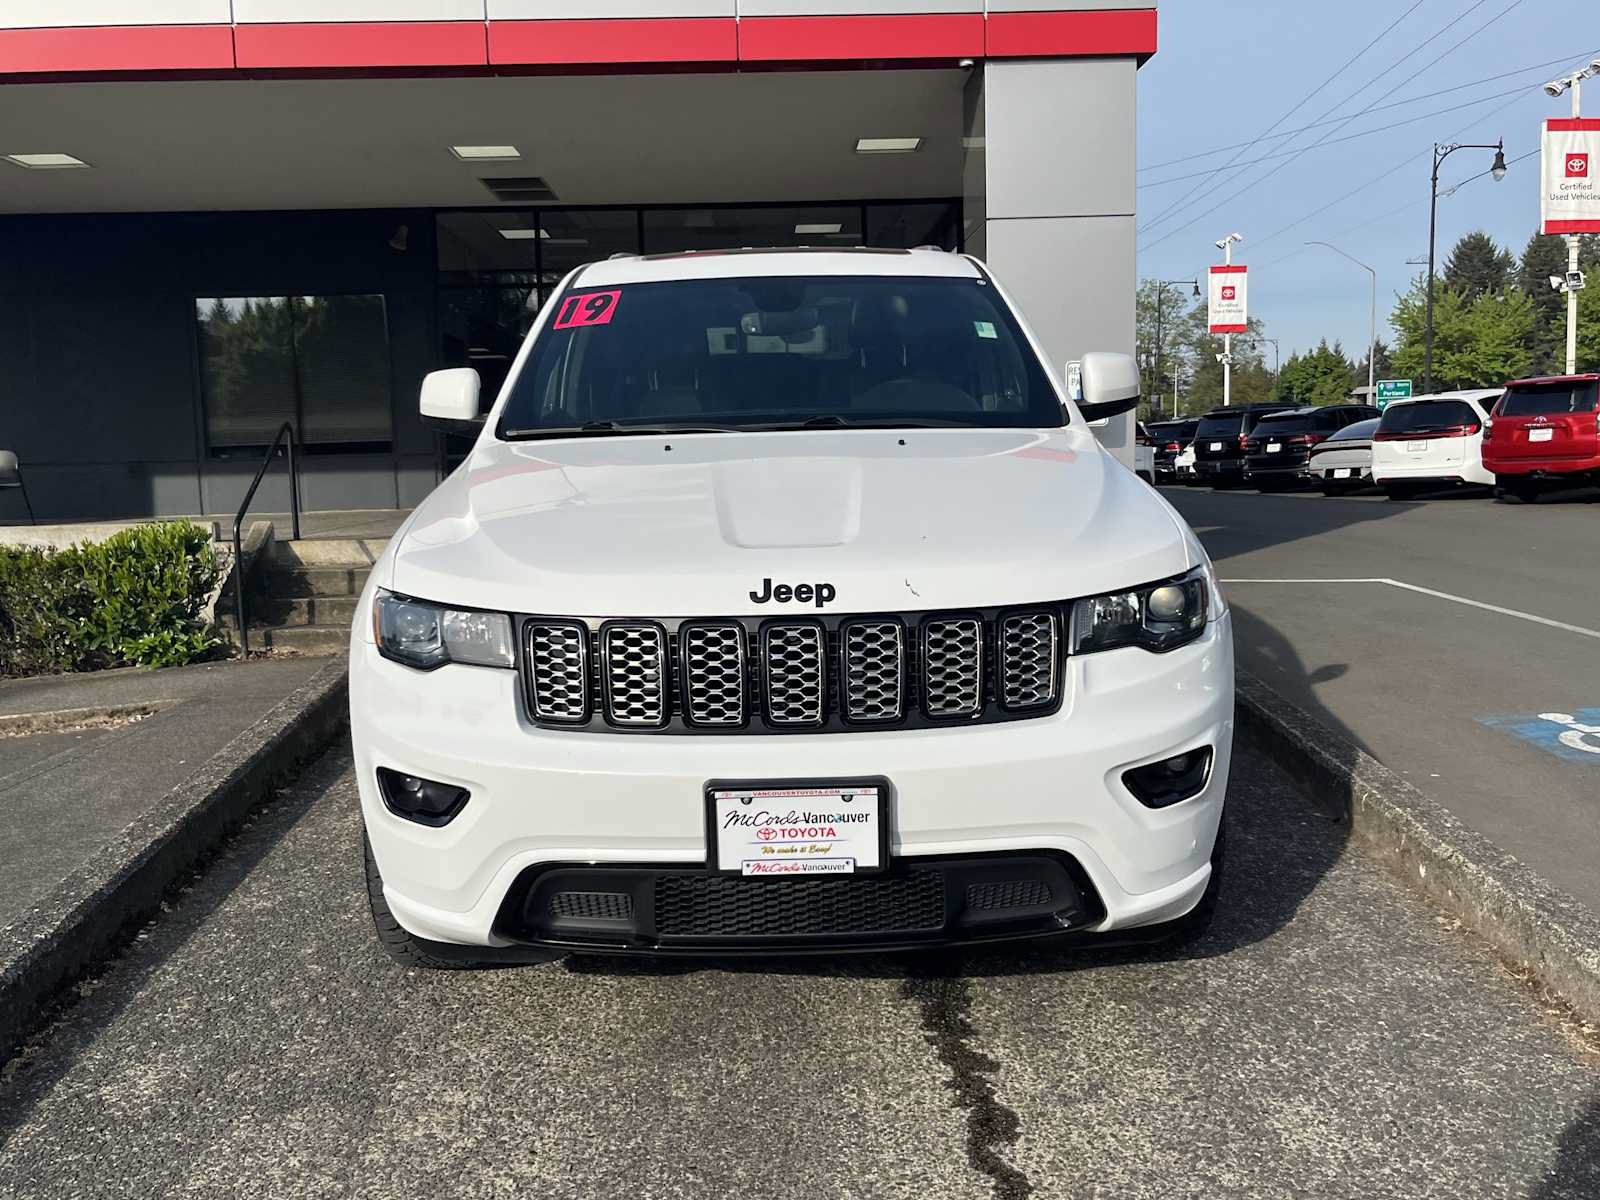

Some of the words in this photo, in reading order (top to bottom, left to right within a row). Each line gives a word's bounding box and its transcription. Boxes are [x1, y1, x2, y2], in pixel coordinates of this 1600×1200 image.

[1560, 182, 1592, 190] Certified
[559, 294, 613, 323] 19
[749, 578, 836, 608] Jeep
[803, 811, 870, 824] Vancouver
[780, 827, 837, 838] TOYOTA
